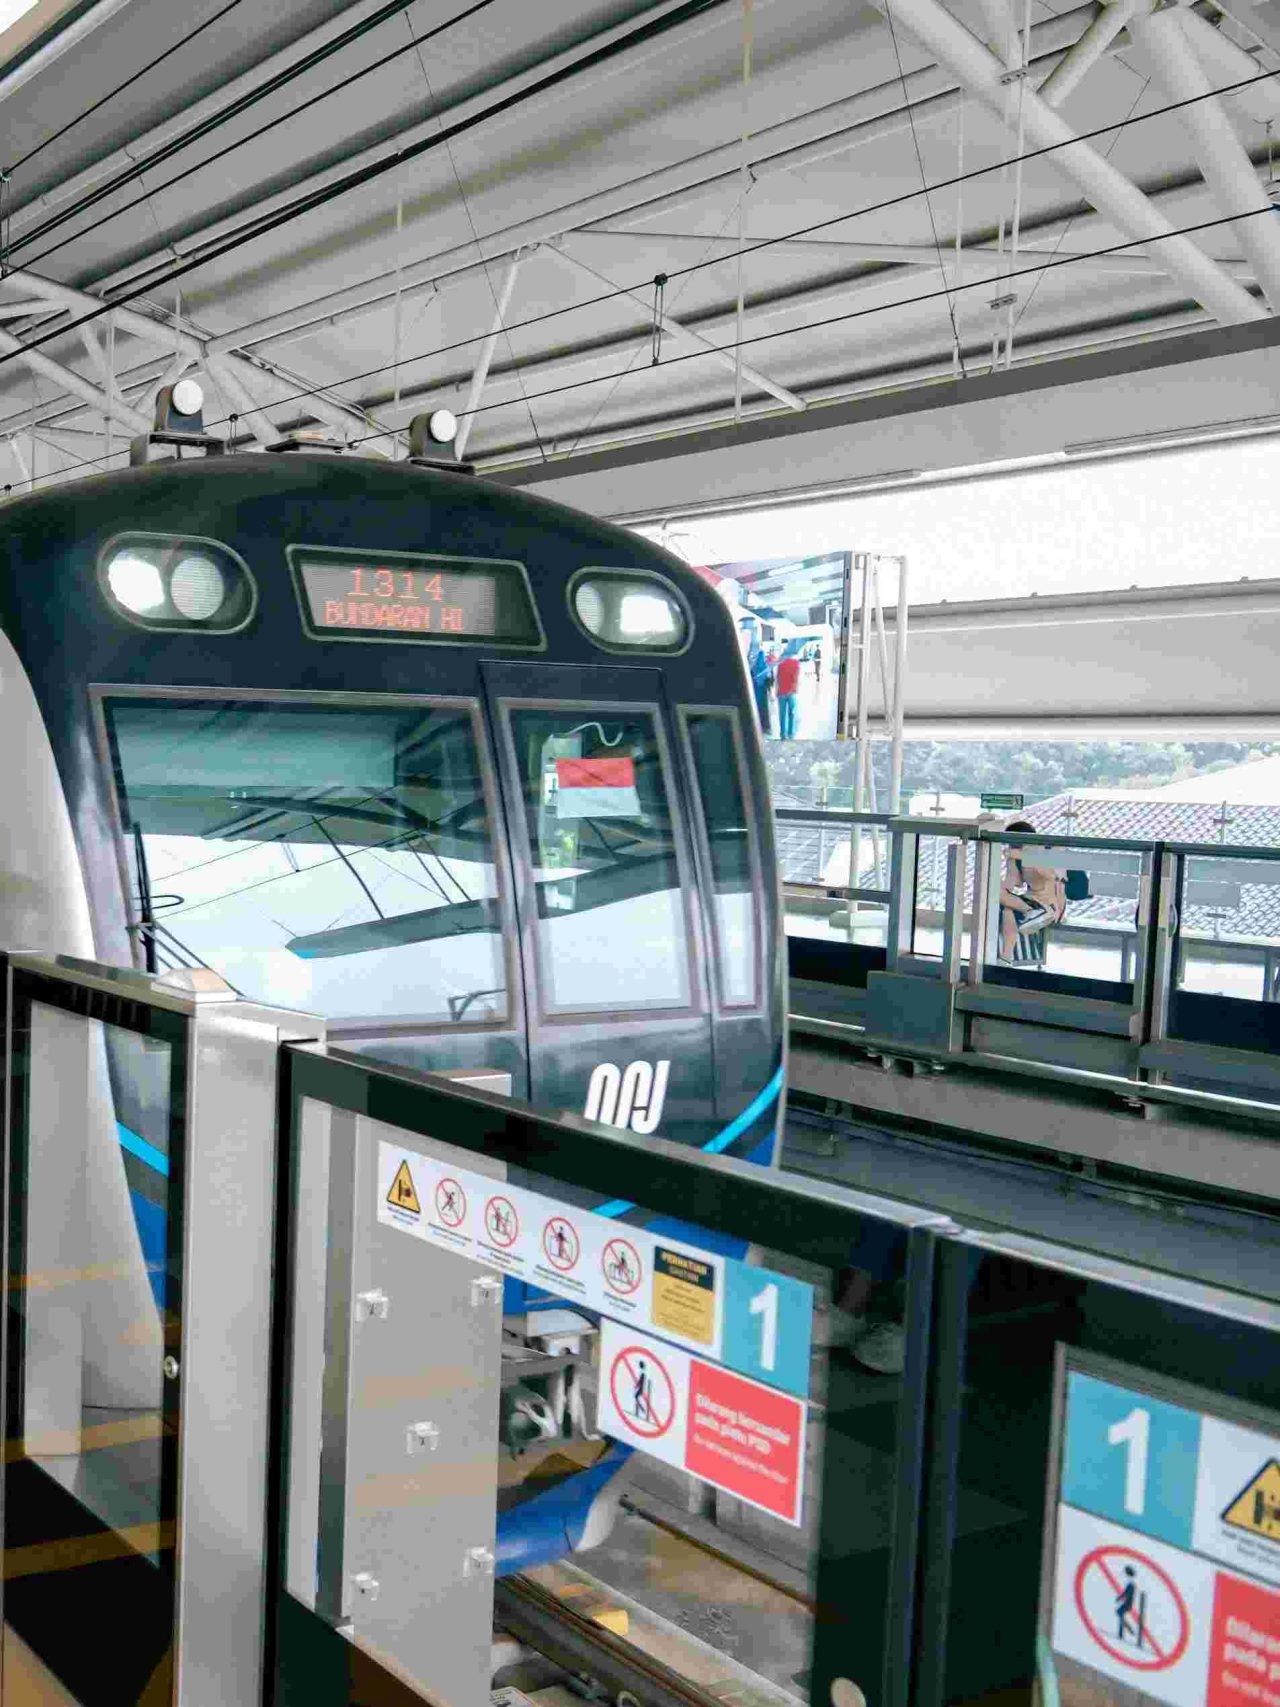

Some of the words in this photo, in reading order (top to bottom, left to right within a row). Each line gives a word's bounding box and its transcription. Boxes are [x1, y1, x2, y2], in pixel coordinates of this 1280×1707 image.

[345, 566, 444, 602] 1314
[749, 1282, 780, 1372] 1
[1107, 1407, 1151, 1516] 1
